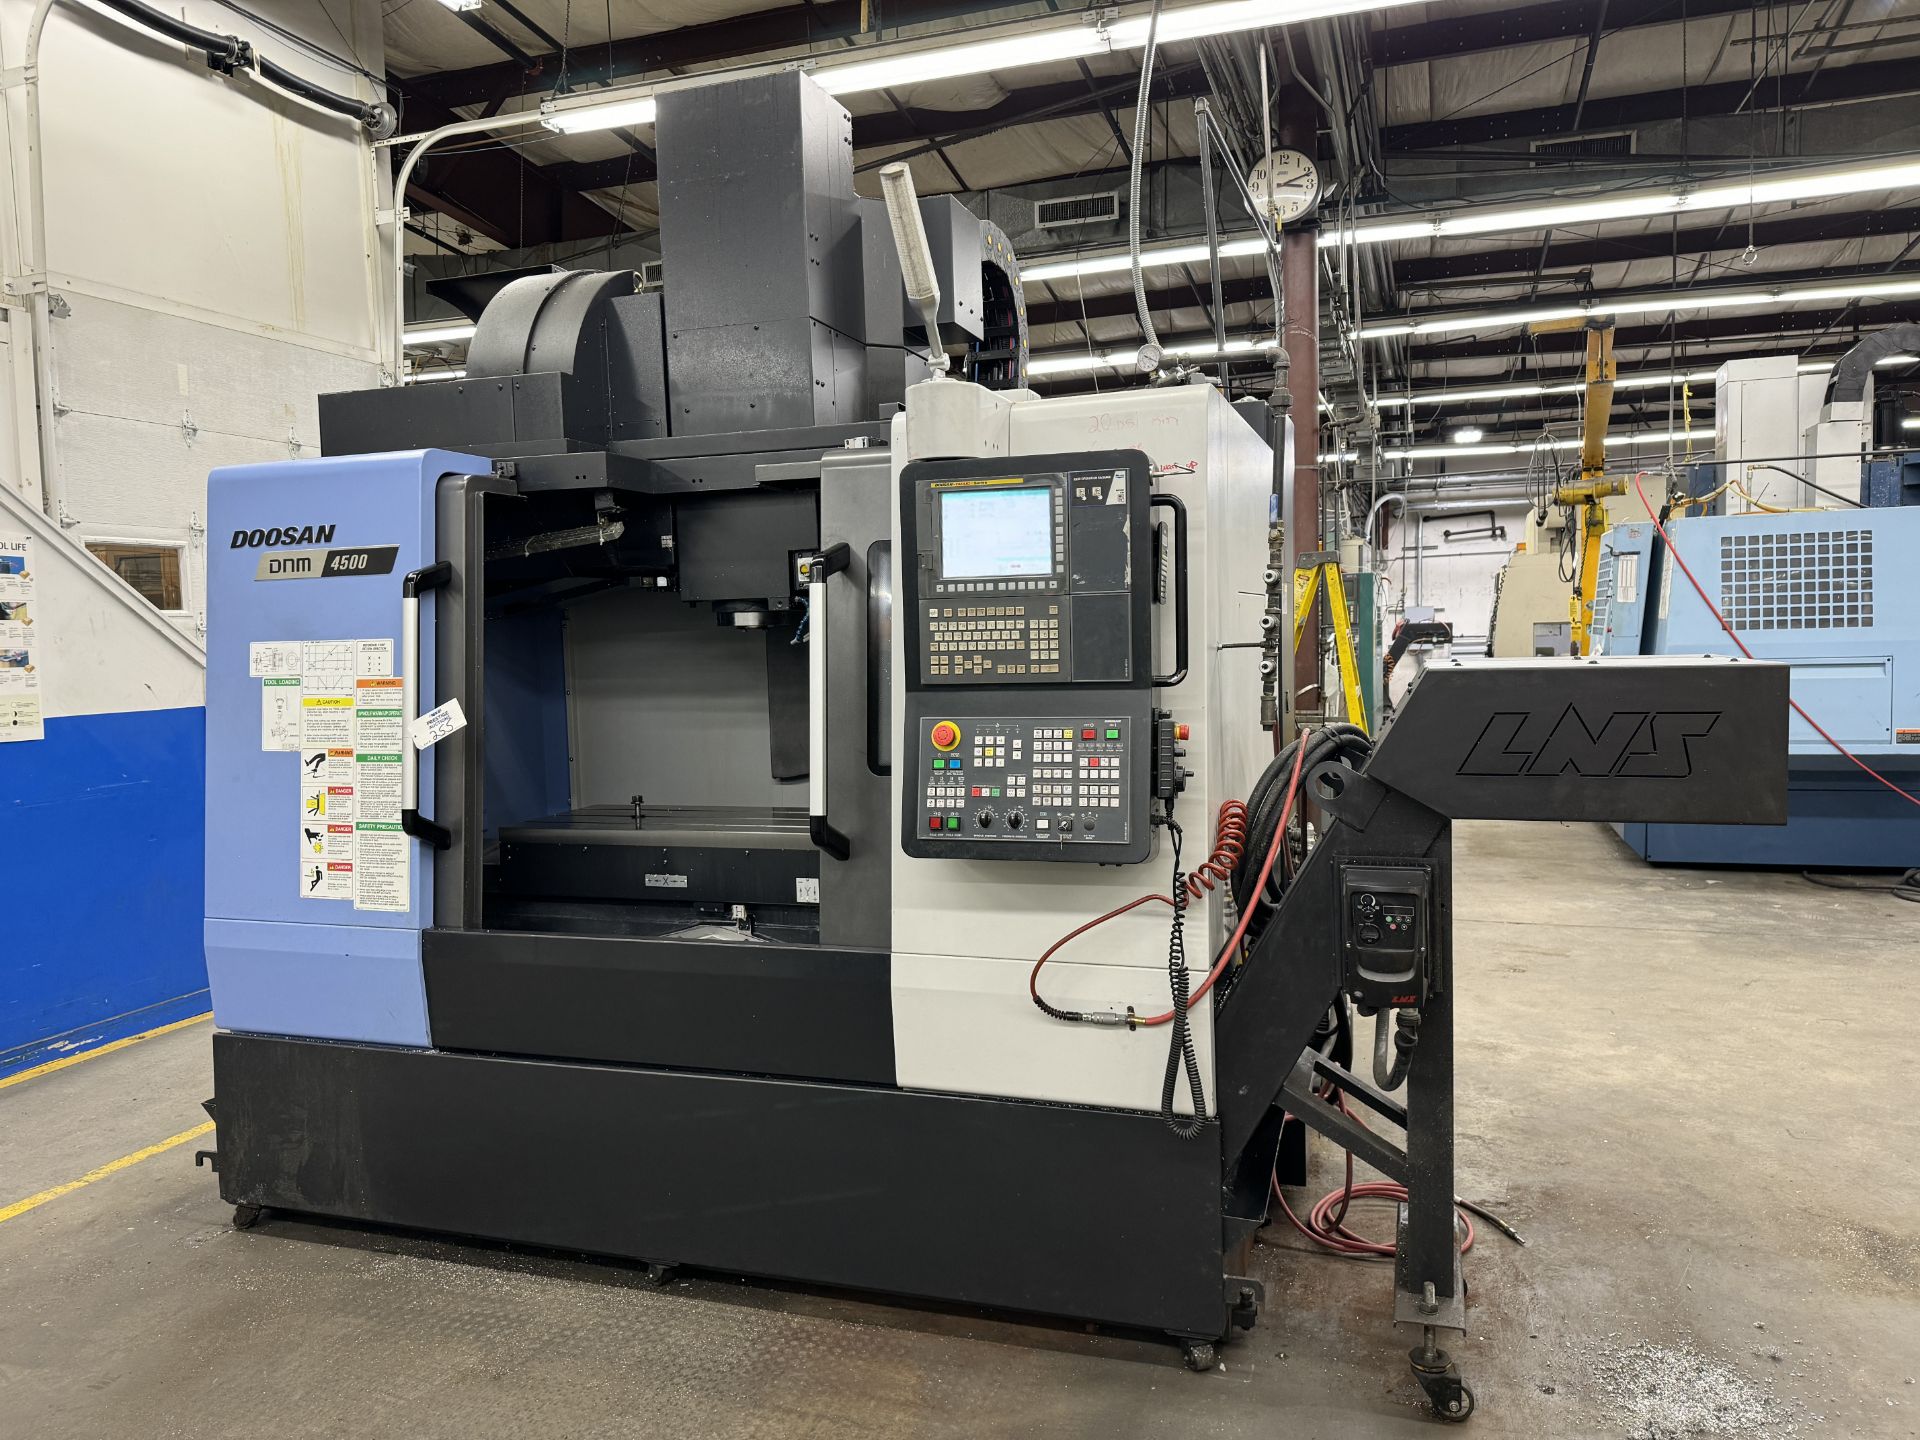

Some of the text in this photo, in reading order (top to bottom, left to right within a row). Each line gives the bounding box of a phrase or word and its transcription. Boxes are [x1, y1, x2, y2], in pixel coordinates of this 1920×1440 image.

[1280, 154, 1290, 165] 12
[1256, 169, 1267, 180] 10
[1252, 182, 1260, 193] 9
[1306, 179, 1314, 190] 3
[231, 525, 336, 549] DOOSAN
[11, 542, 27, 552] LIFE
[331, 554, 368, 571] 4500
[1456, 702, 1723, 779] LNS
